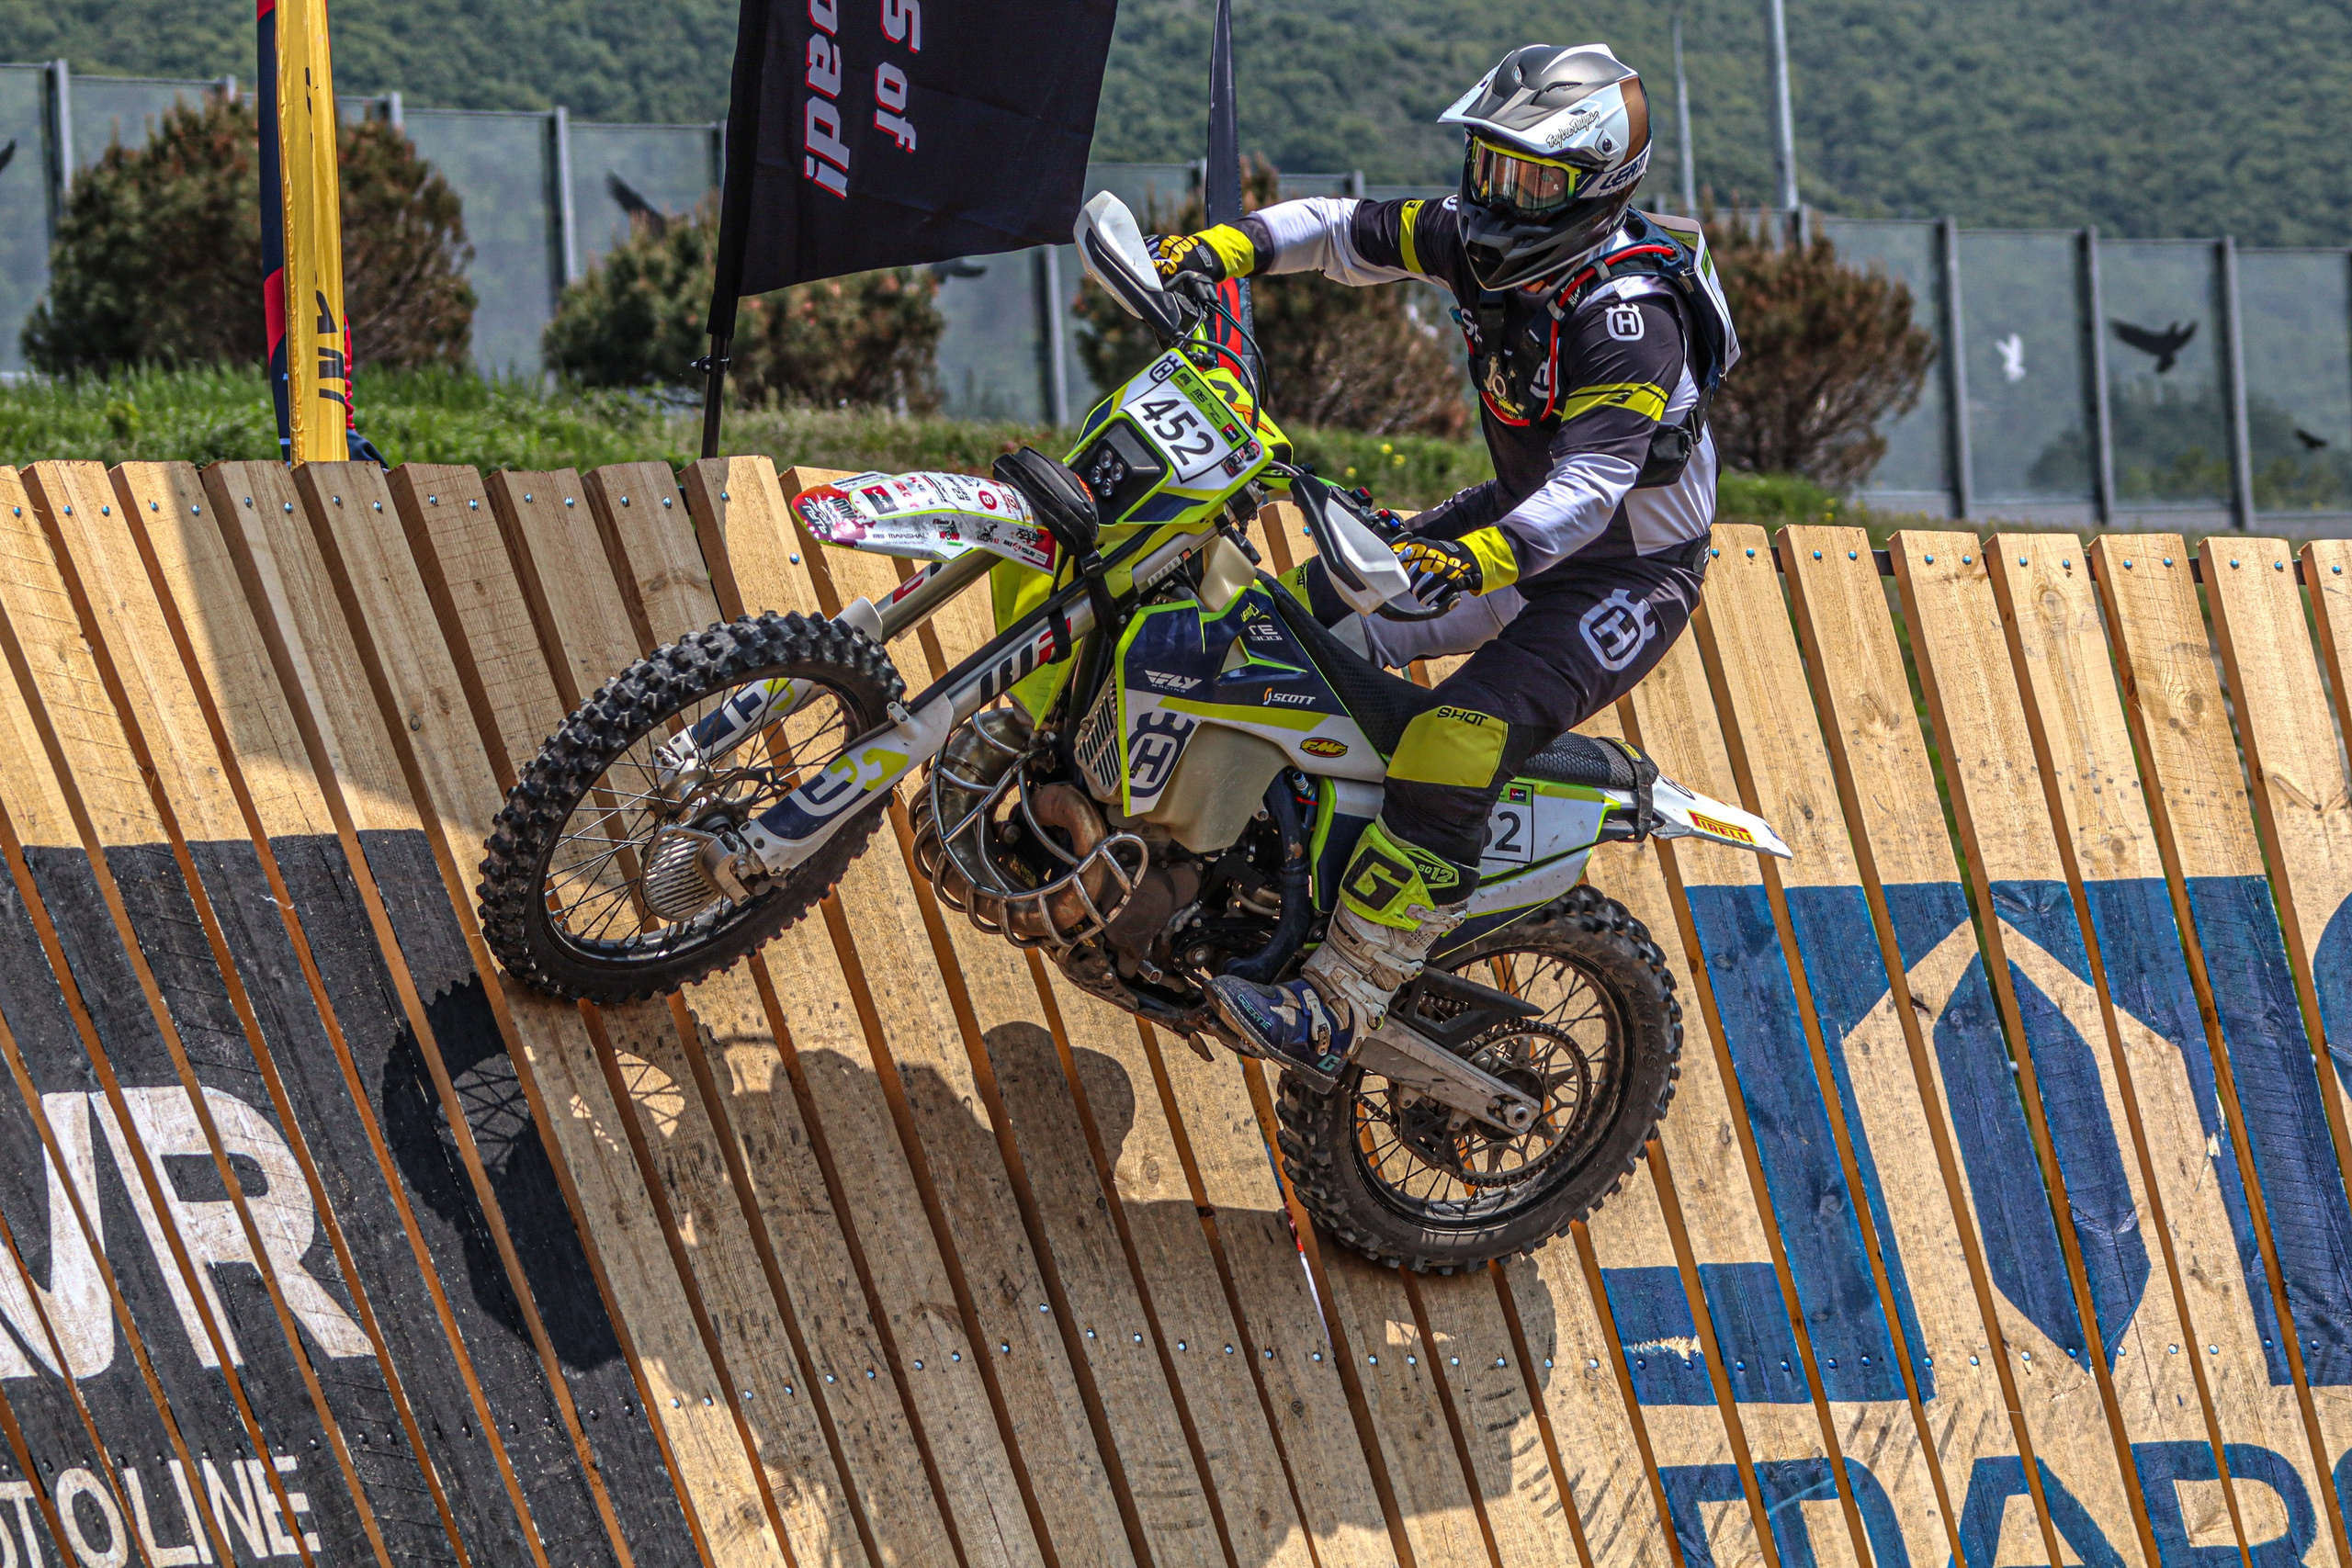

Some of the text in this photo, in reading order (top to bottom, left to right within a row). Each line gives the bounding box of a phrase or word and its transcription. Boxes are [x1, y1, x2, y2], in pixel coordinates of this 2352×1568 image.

[874, 62, 917, 152] of
[1140, 399, 1215, 466] 452
[871, 489, 889, 509] LAVR
[1145, 670, 1203, 689] FLY
[1151, 683, 1186, 693] RACING
[1272, 693, 1316, 705] SCOTT
[1436, 705, 1489, 726] SHOT
[1301, 740, 1349, 756] FMF
[1688, 809, 1754, 843] PIRELLI
[0, 1455, 322, 1568] TOLINE
